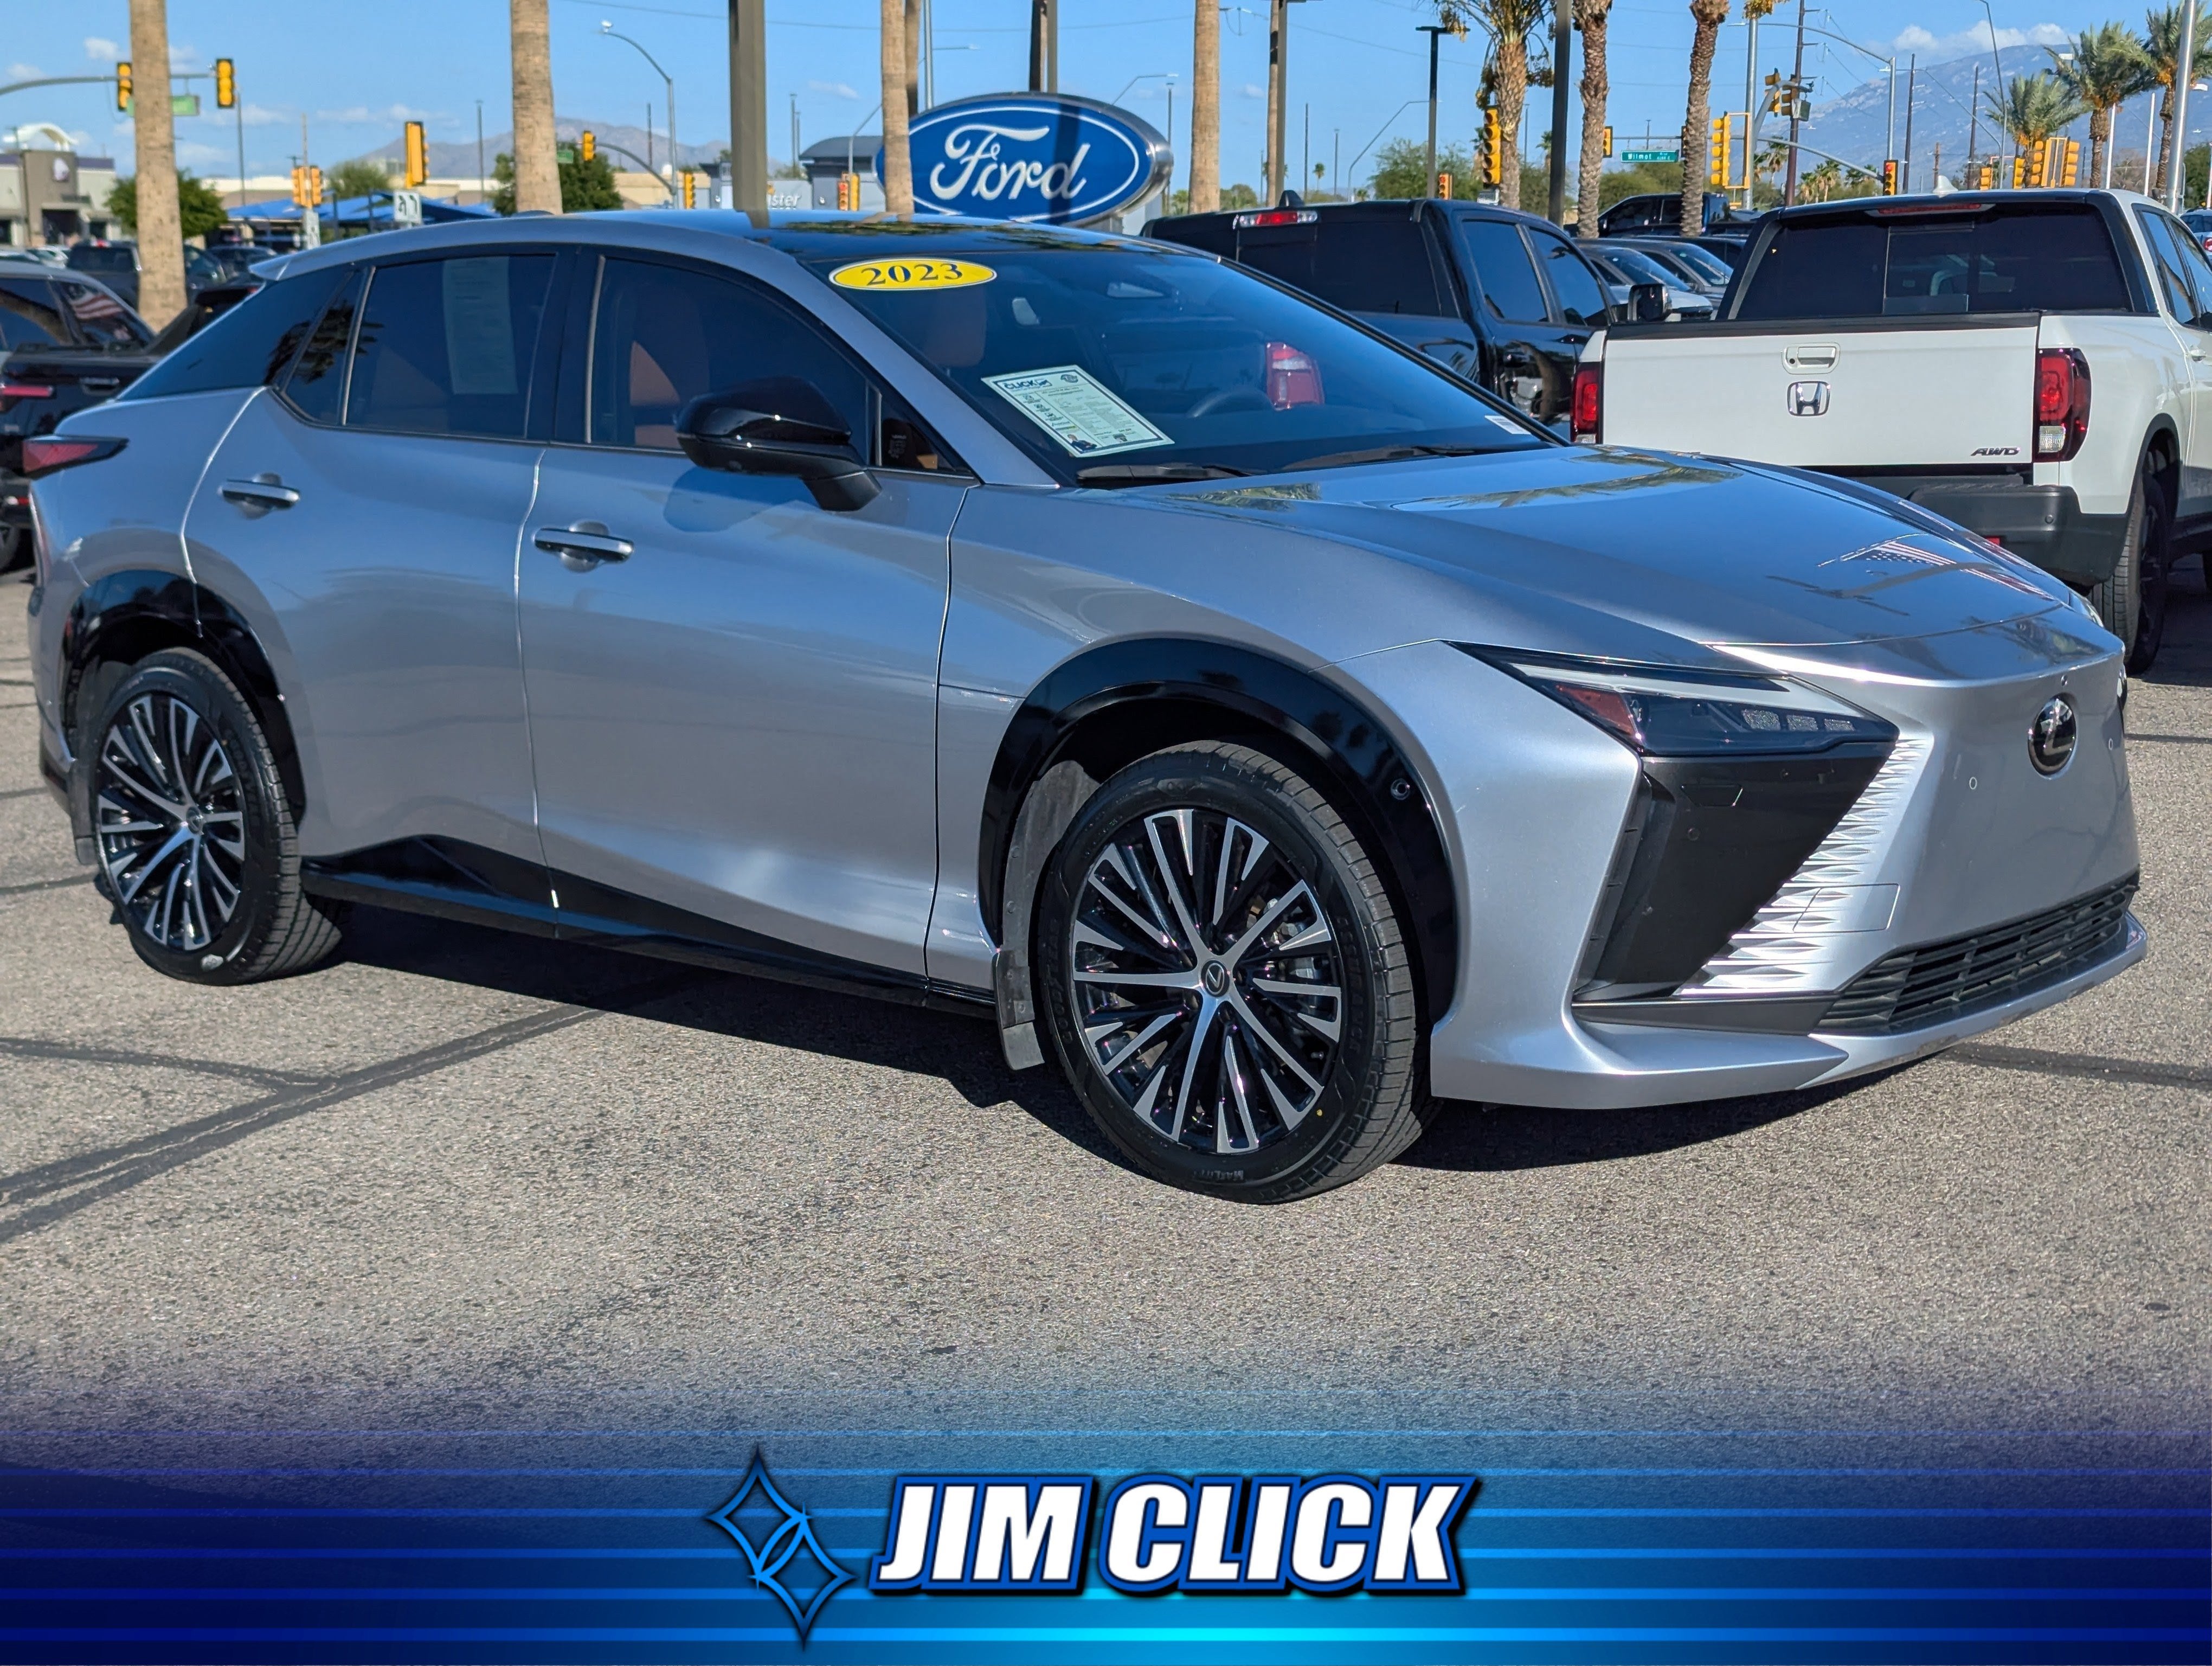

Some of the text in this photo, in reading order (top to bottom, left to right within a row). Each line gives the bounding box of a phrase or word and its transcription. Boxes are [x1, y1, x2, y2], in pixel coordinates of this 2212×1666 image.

[929, 124, 1091, 201] Ford
[768, 194, 801, 207] ister
[860, 263, 963, 286] 2023
[1004, 380, 1037, 389] CLICK
[1970, 447, 2022, 457] AWD
